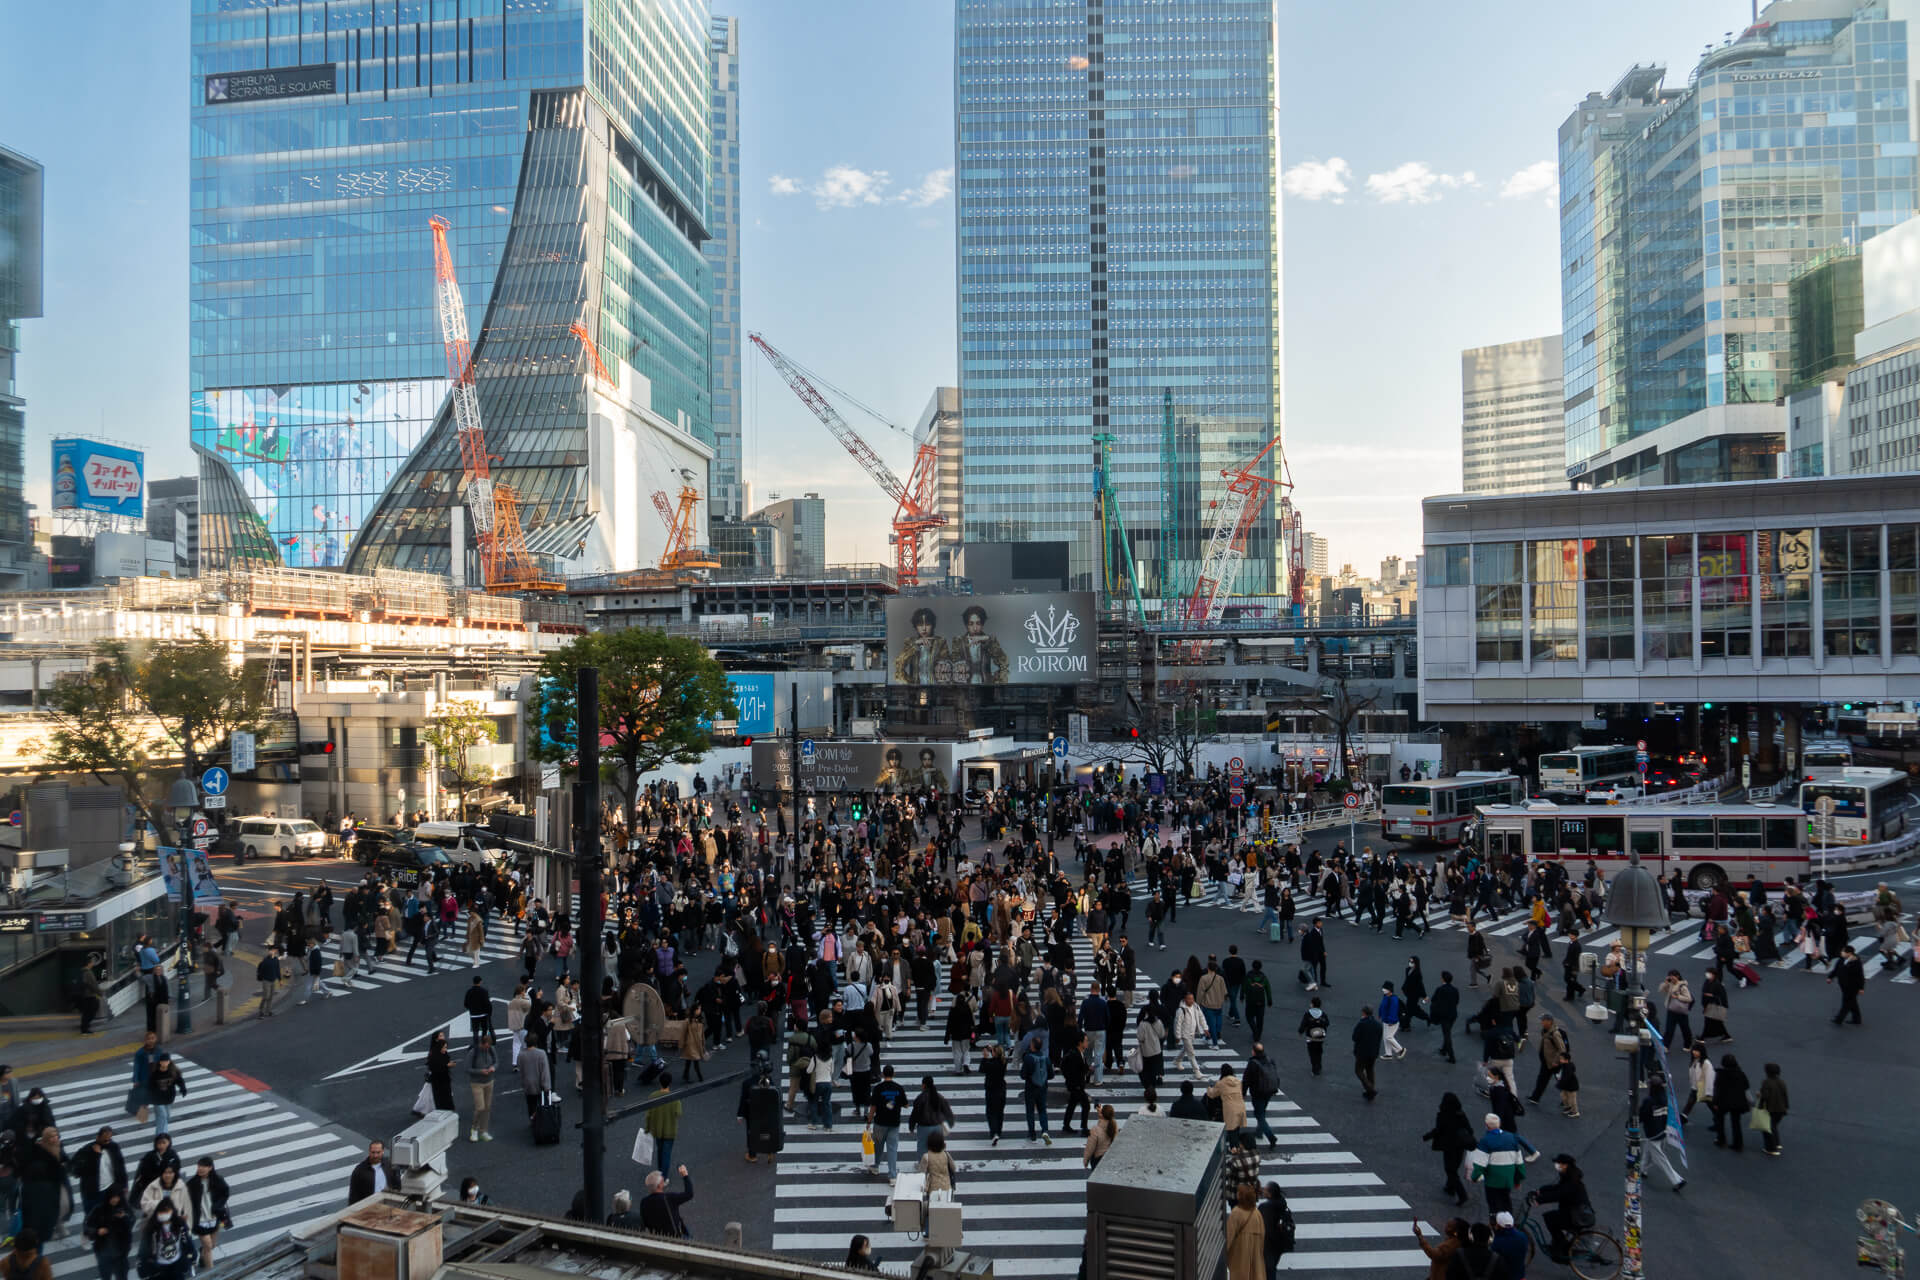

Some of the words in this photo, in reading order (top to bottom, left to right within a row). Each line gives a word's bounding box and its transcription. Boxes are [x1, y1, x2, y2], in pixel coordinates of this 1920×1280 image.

[230, 73, 276, 89] SHIBUYA
[1732, 72, 1775, 82] TOKYU
[1778, 69, 1824, 80] PLAZA
[230, 84, 286, 98] SCRAMBLE
[288, 79, 333, 94] SQUARE
[91, 462, 133, 479] ファイト
[1017, 655, 1088, 673] ROIROM
[816, 775, 848, 787] DIVA
